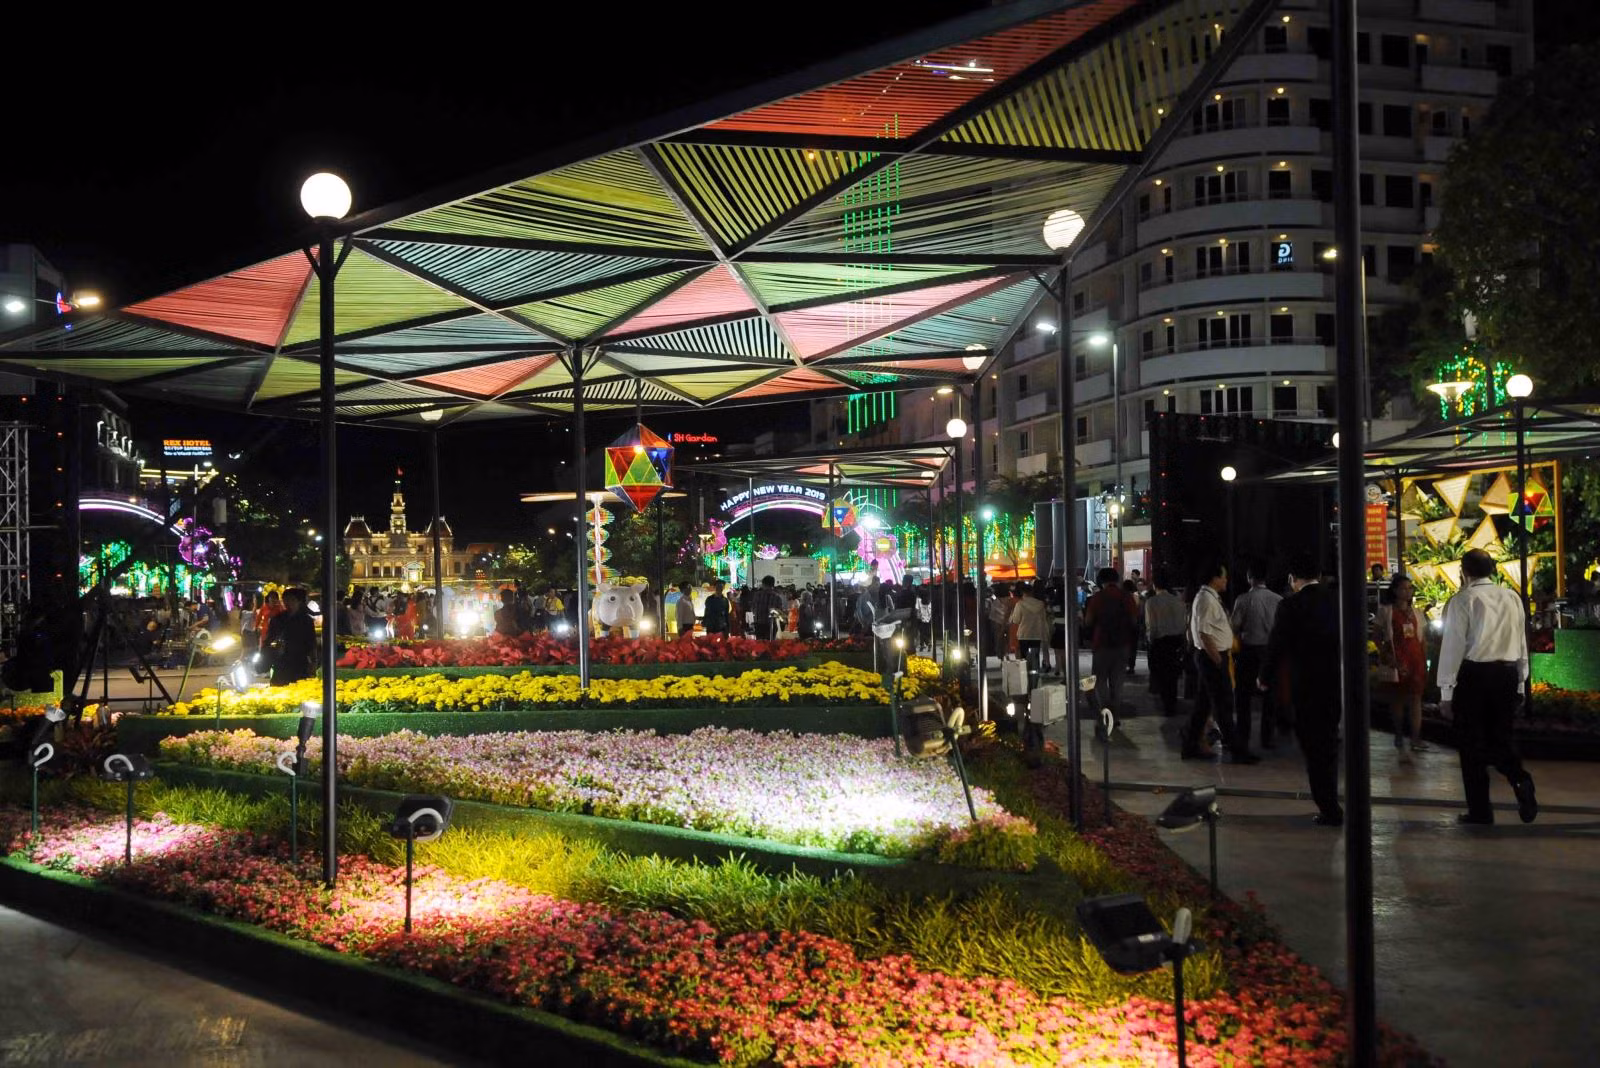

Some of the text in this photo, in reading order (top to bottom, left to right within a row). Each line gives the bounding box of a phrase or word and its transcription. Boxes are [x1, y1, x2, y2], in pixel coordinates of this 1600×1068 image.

[720, 485, 826, 511] HAPPY NEW YEAR 2019
